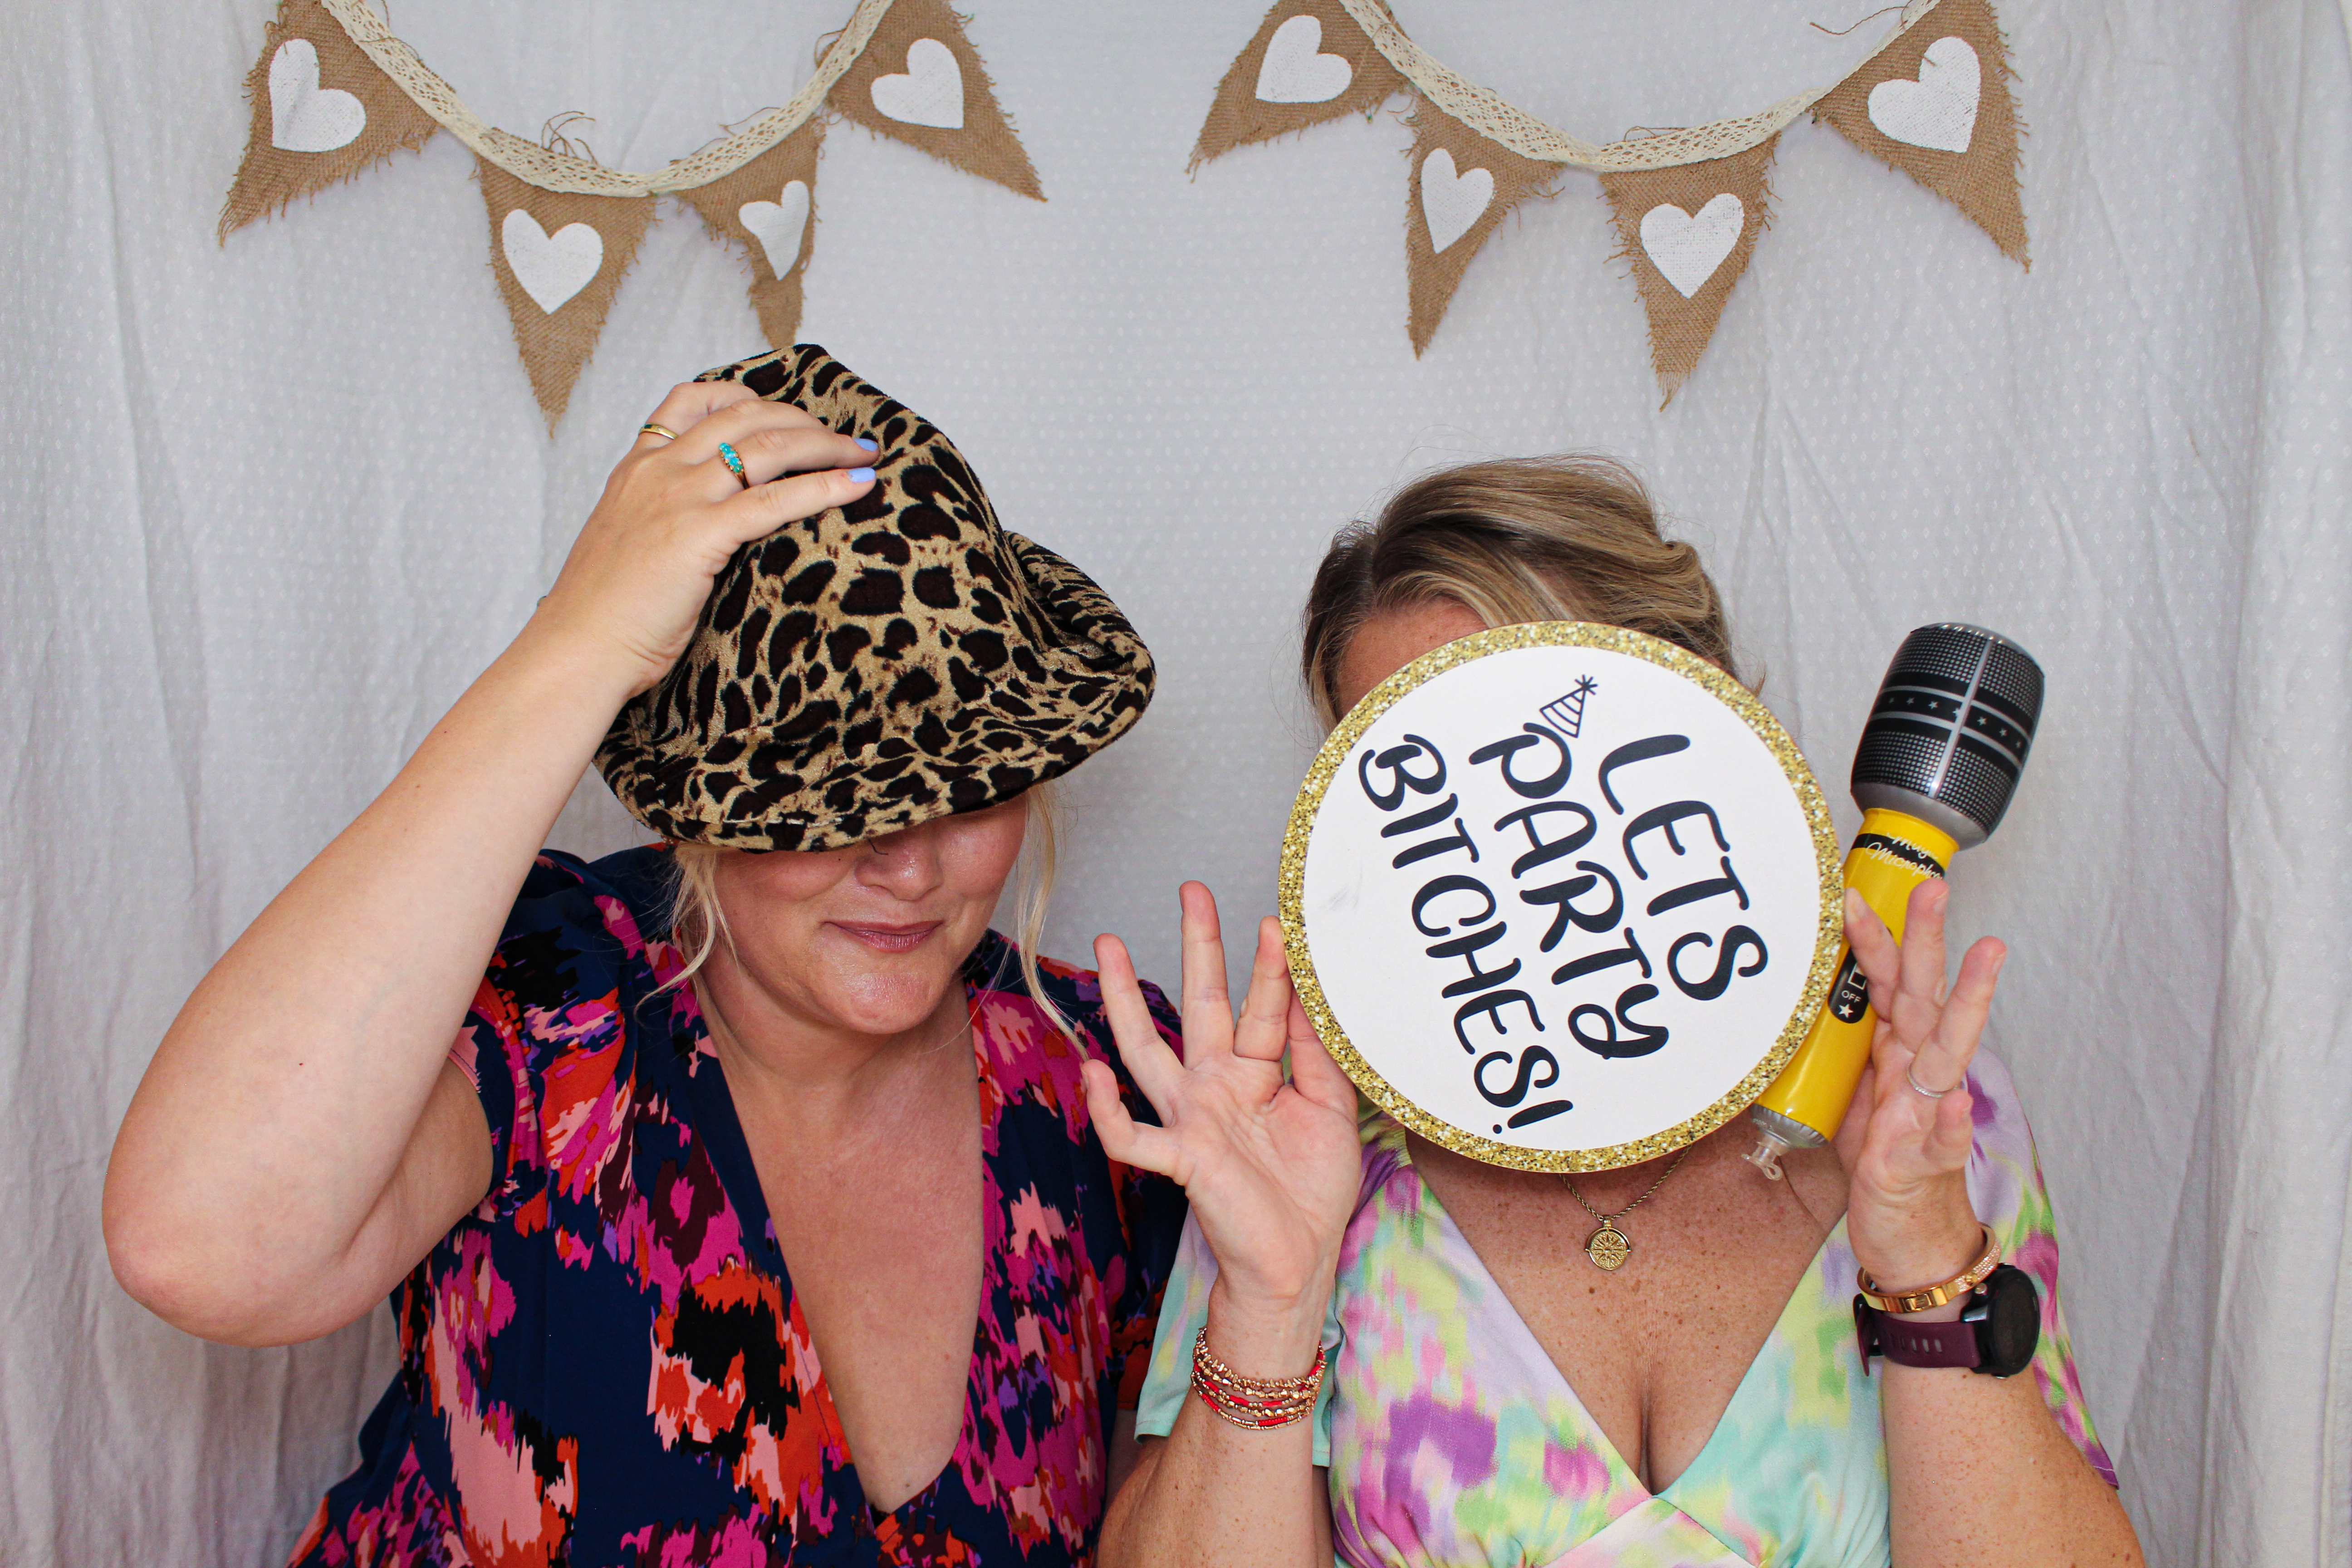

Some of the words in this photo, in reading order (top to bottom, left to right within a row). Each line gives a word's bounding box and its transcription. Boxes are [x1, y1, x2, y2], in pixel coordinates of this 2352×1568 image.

[1358, 734, 1574, 1135] BITCHES!
[1598, 734, 1769, 1001] LETS
[1865, 842, 1944, 880] Micropho
[1841, 990, 1862, 1003] OFF
